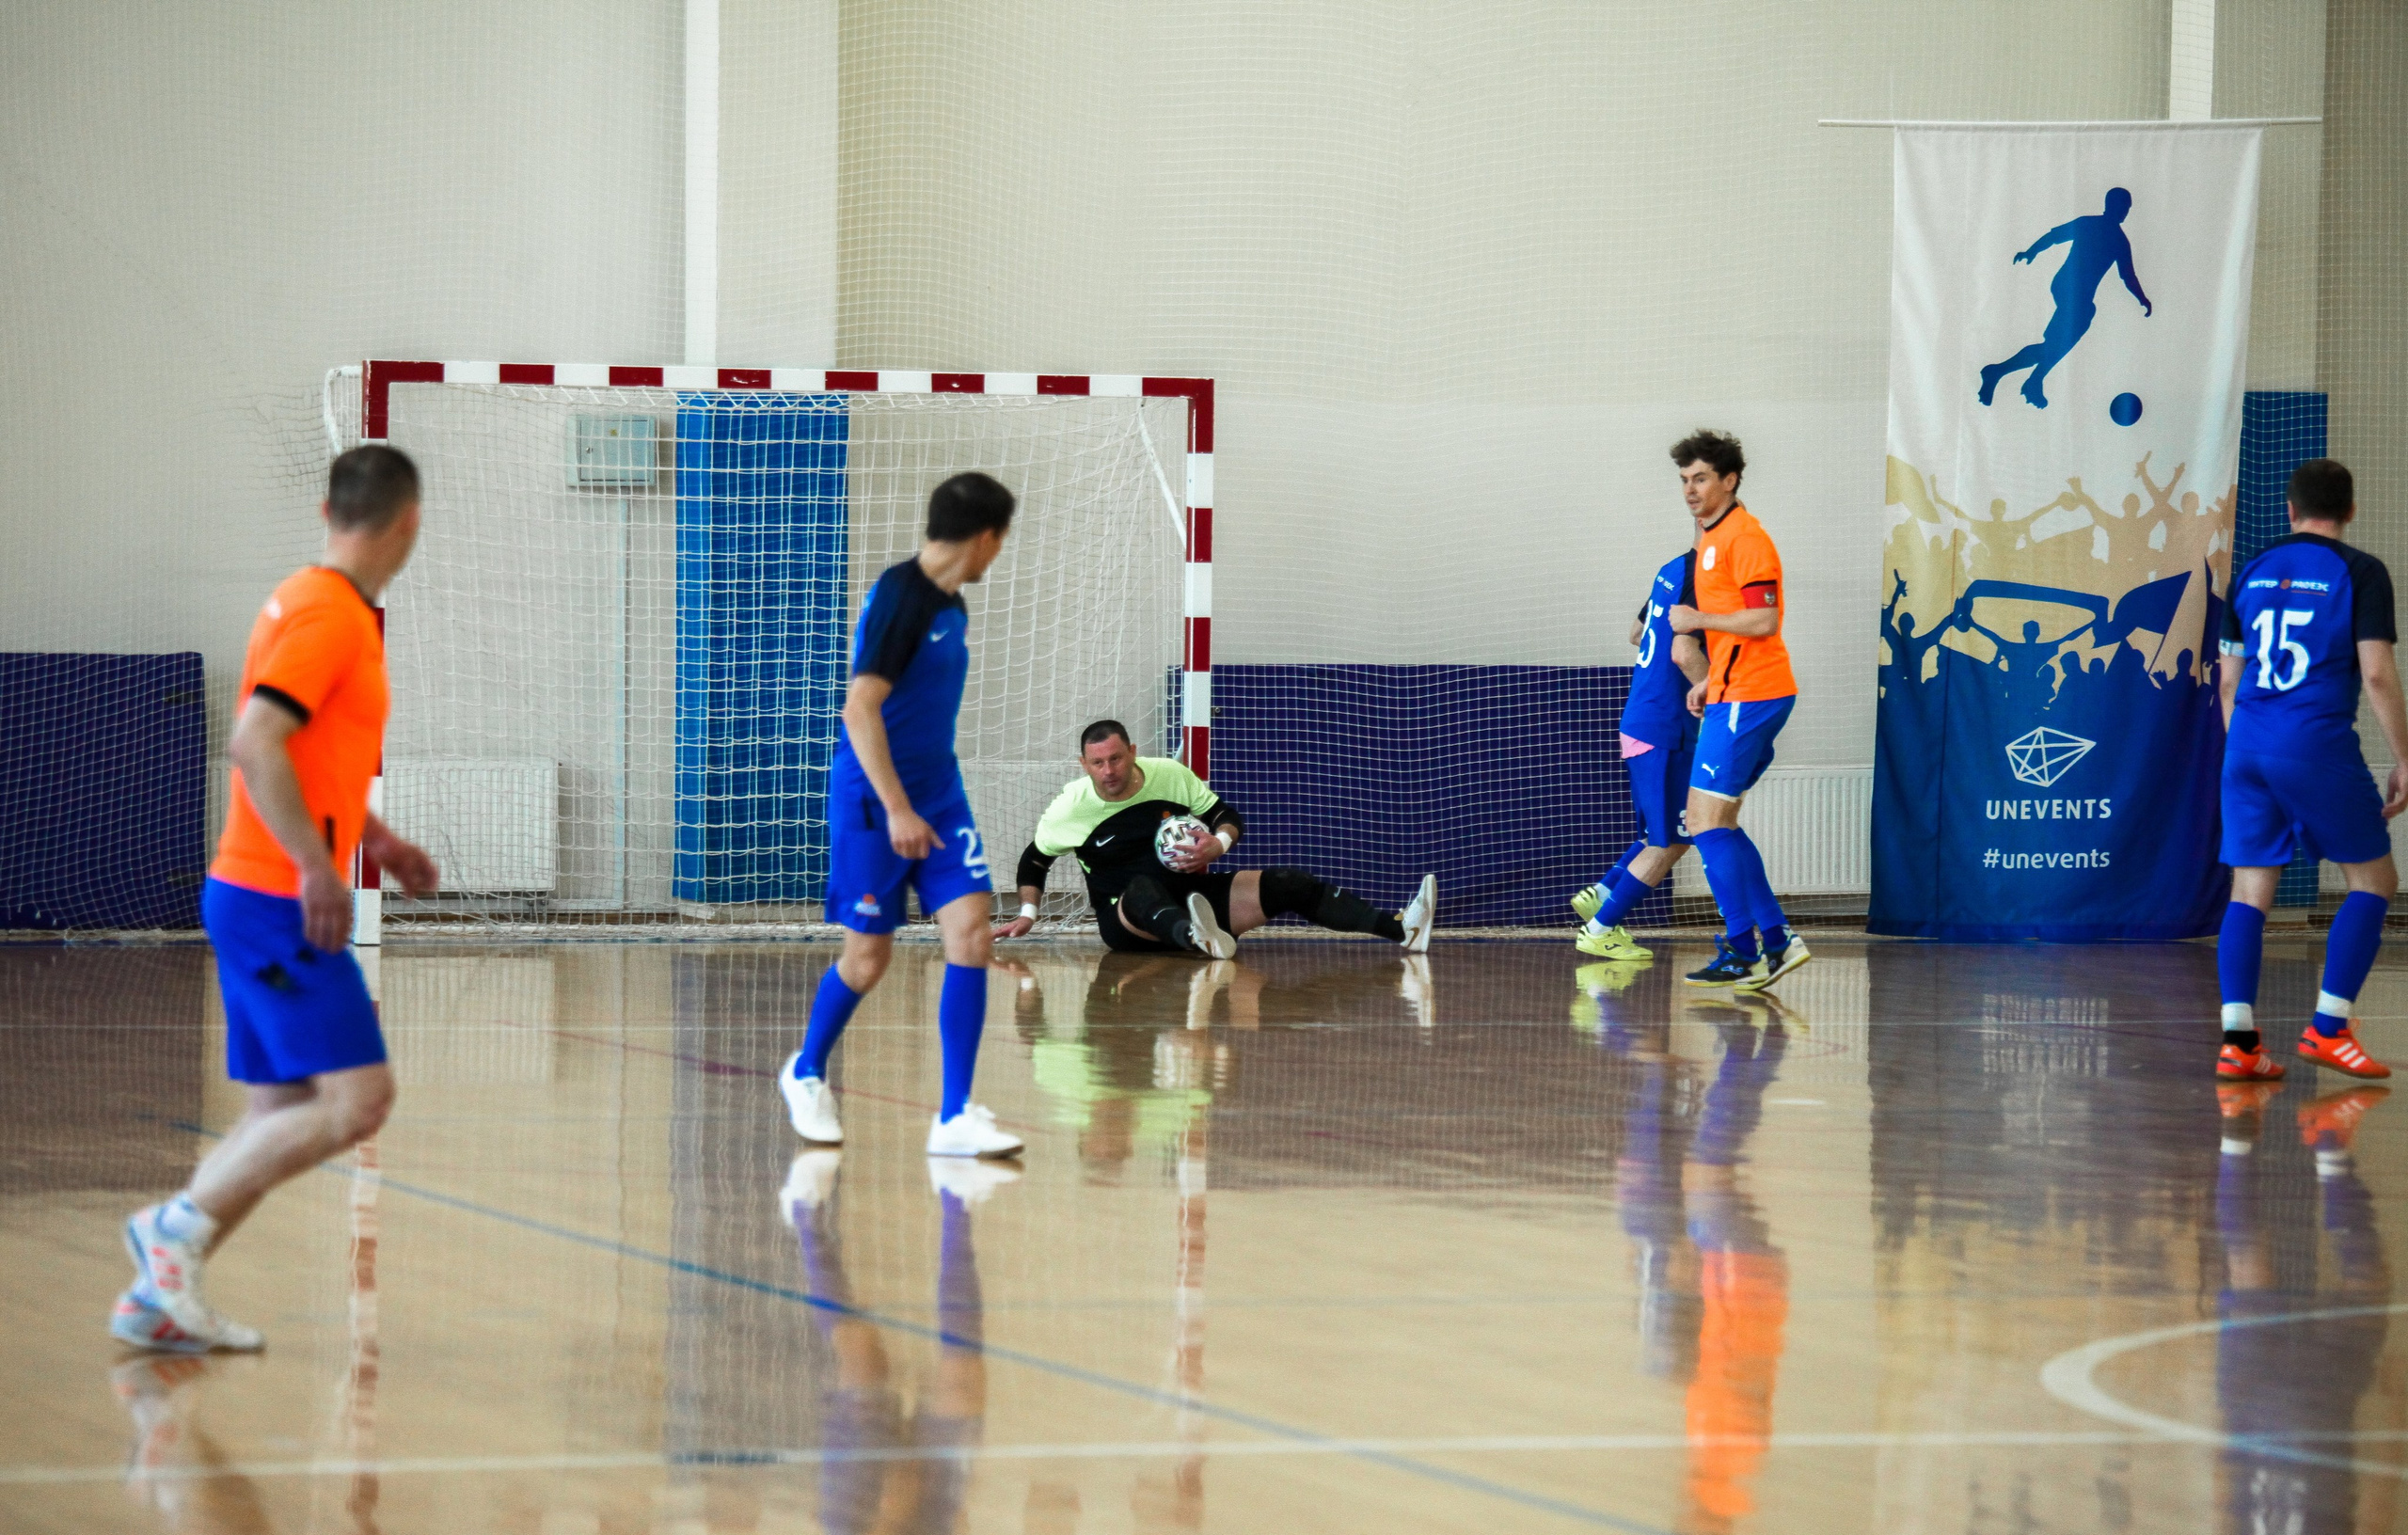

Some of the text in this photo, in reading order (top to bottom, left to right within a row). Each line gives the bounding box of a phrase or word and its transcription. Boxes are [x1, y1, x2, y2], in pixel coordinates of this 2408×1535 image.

[2251, 609, 2315, 691] 15
[1986, 799, 2113, 820] UNEVENTS
[1982, 848, 2111, 869] #unevents
